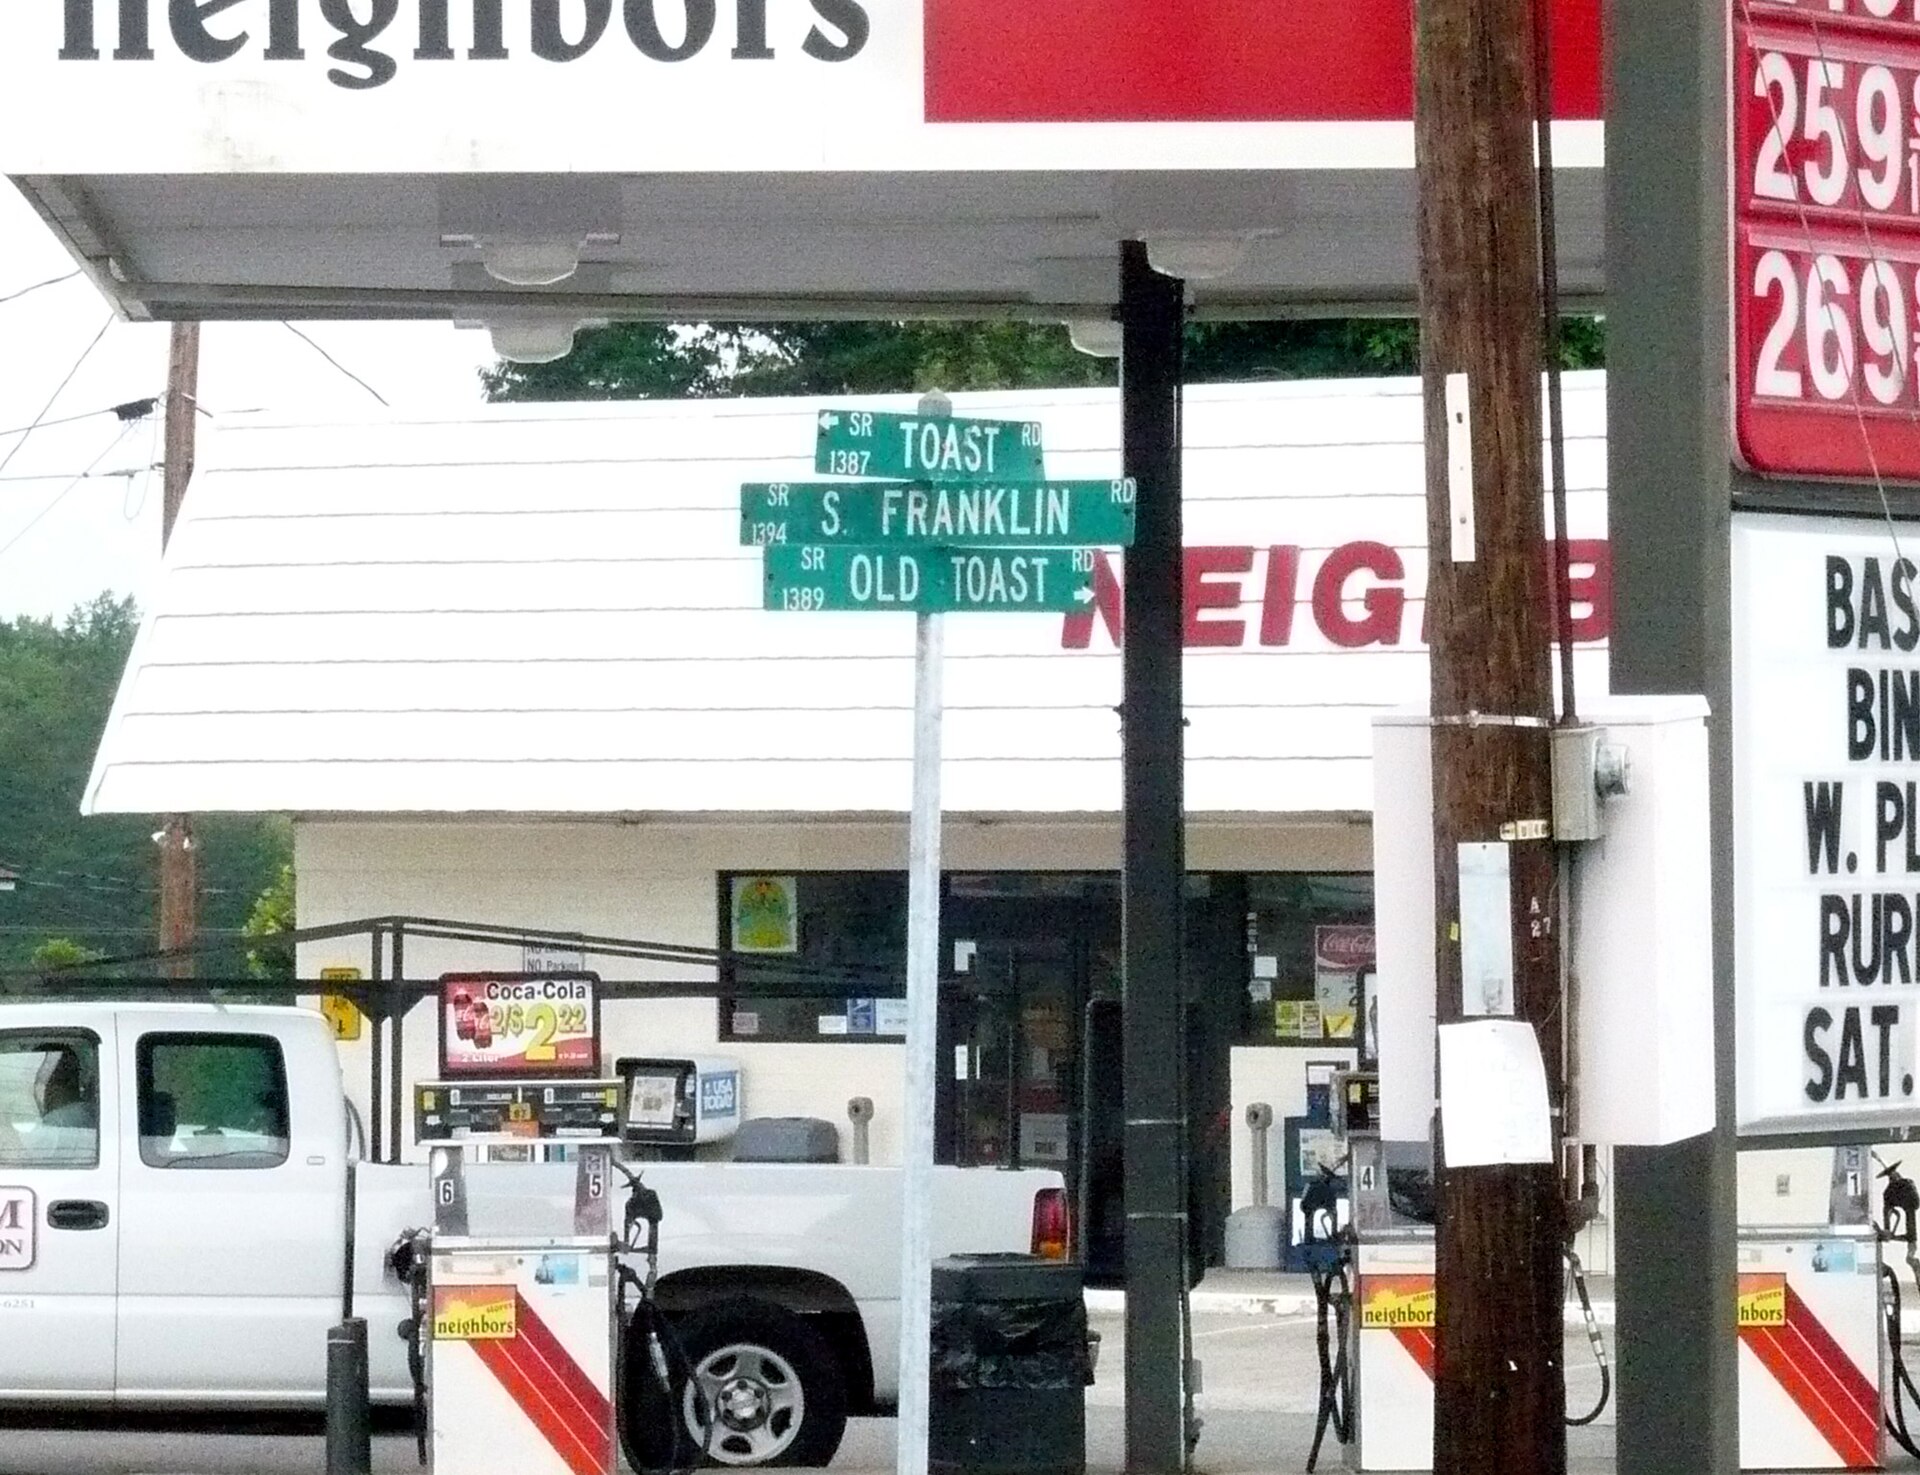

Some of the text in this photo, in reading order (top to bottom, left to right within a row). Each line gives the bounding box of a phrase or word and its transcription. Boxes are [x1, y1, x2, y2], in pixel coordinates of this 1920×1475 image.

[1754, 52, 1903, 210] 259
[1754, 250, 1908, 404] 269
[829, 449, 871, 475] 1387
[849, 412, 1042, 473] SR TOAST RD
[767, 477, 1136, 536] SR S. FRANKLIN RD
[751, 522, 786, 545] 1394
[801, 547, 1094, 603] SR OLD TOAST RD
[782, 587, 824, 611] 1389
[1803, 781, 1858, 875] W.
[1819, 893, 1920, 987] RUR
[486, 981, 587, 1001] Coca-Cola
[1803, 1005, 1914, 1103] SAT.
[442, 1181, 452, 1203] 6
[591, 1174, 602, 1197] 5
[1362, 1166, 1373, 1190] 4
[438, 1314, 514, 1337] neighbors
